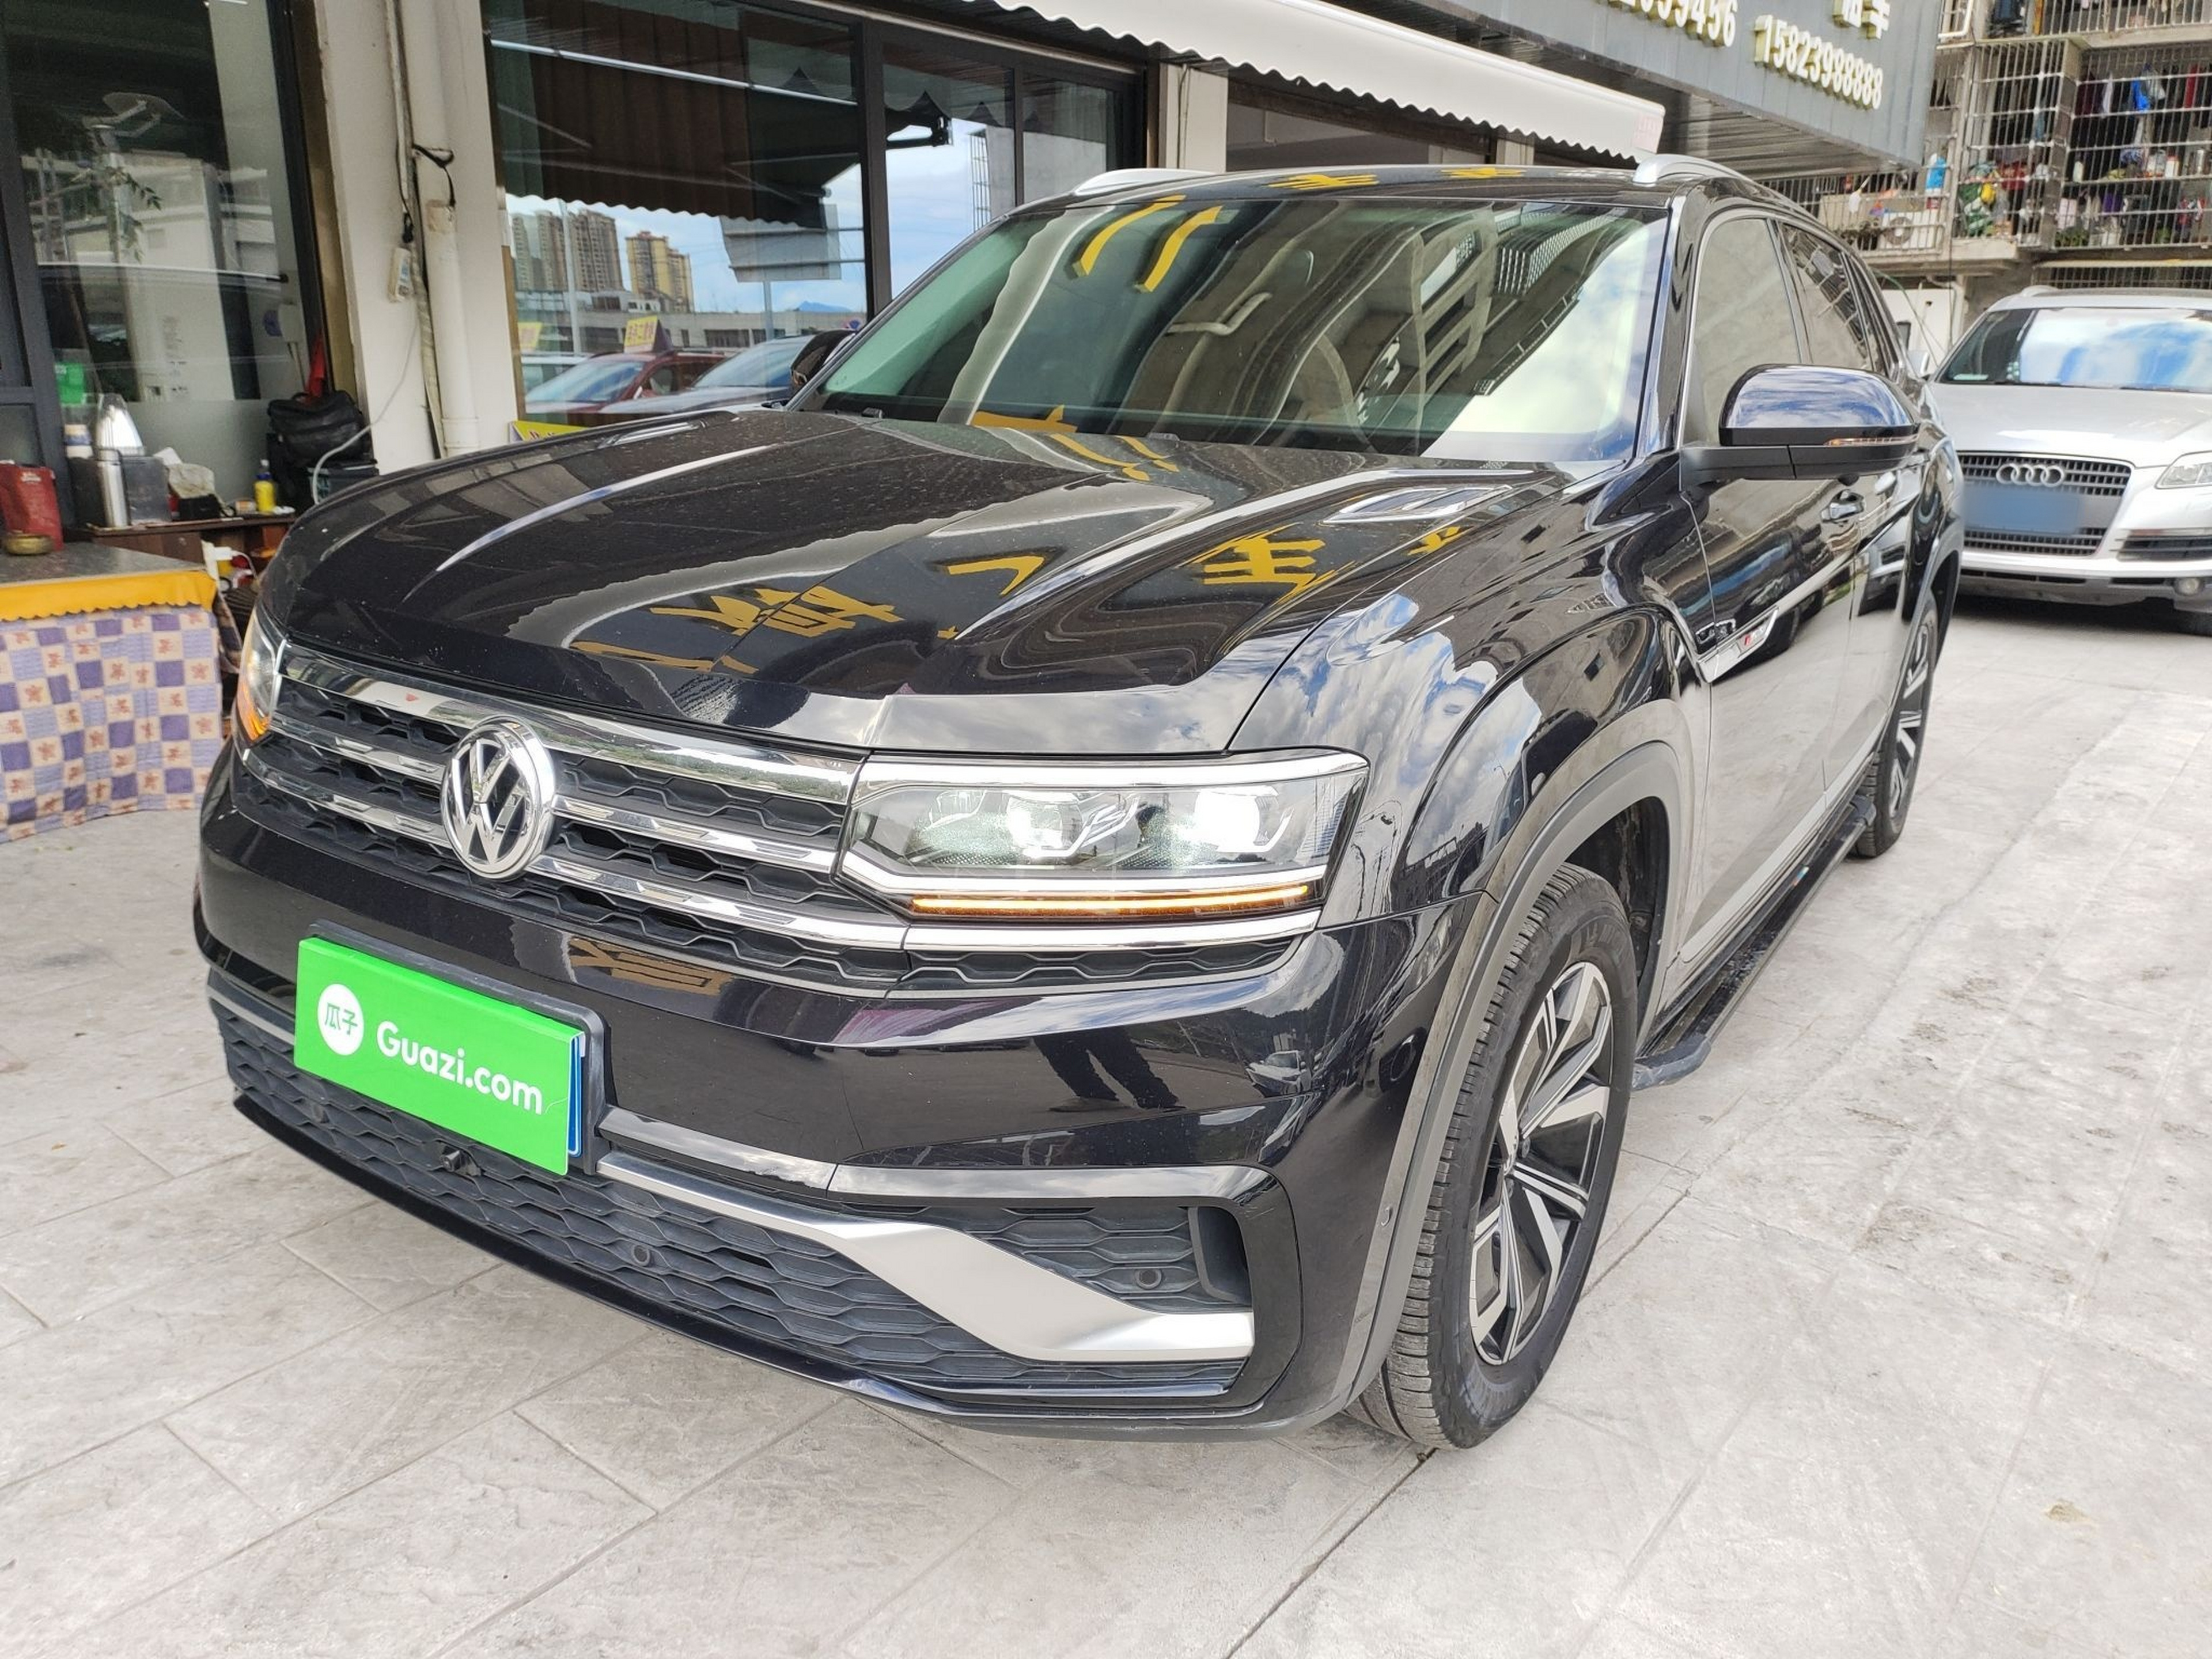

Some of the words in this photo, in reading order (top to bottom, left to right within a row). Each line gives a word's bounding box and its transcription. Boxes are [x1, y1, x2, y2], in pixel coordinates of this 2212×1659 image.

[1755, 15, 1883, 109] 15823988888
[324, 1002, 358, 1035] 瓜子
[377, 1021, 542, 1115] Guazi.com
